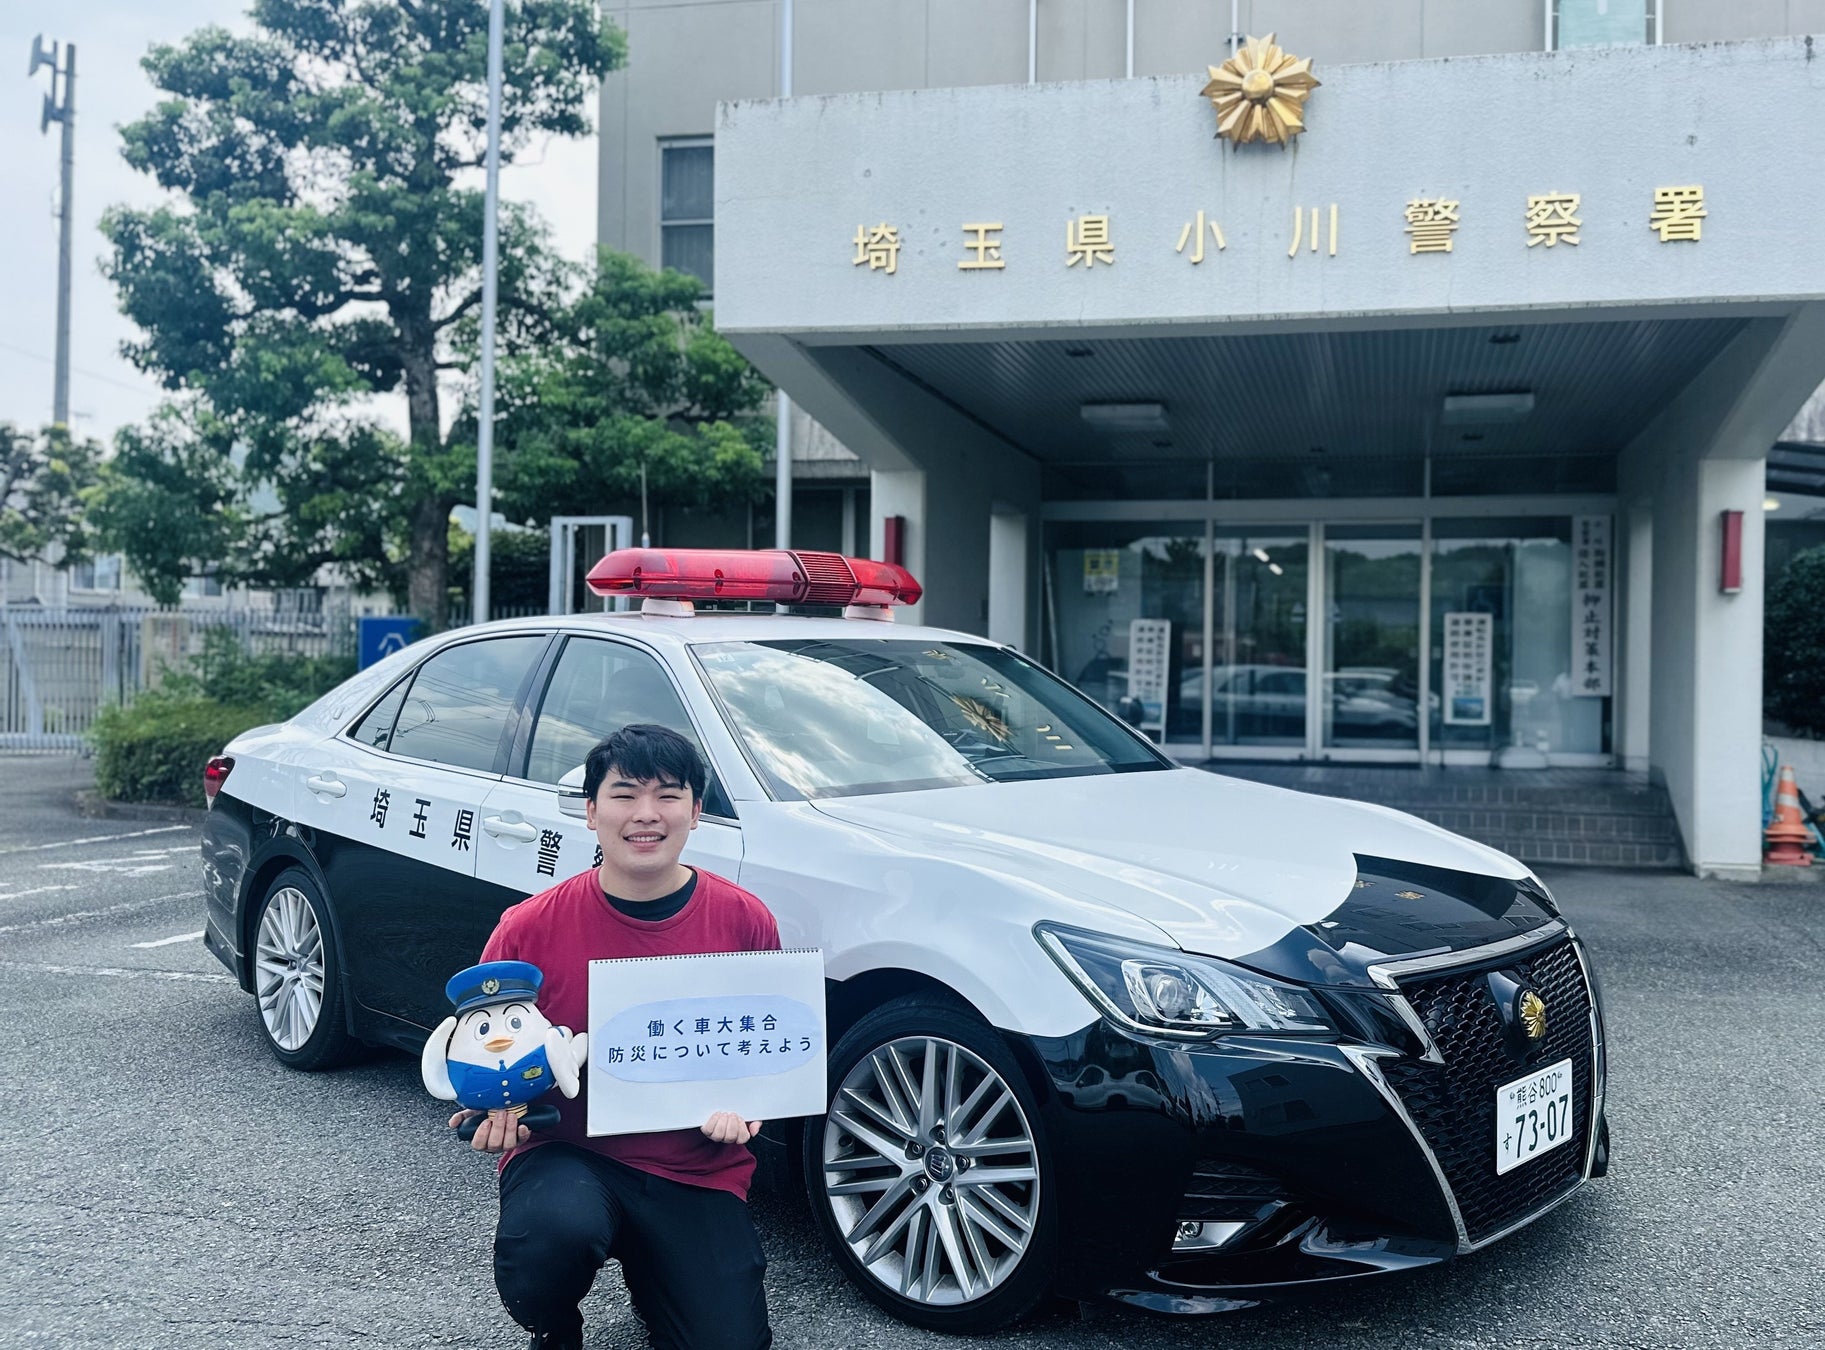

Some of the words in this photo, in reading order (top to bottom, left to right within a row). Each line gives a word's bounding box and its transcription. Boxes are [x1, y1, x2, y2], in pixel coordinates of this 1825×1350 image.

[852, 184, 1708, 274] 埼玉県小川警察署
[647, 1014, 777, 1038] 働く車大集合
[608, 1037, 812, 1063] 防災について考えよう
[1515, 1094, 1568, 1158] 73-07
